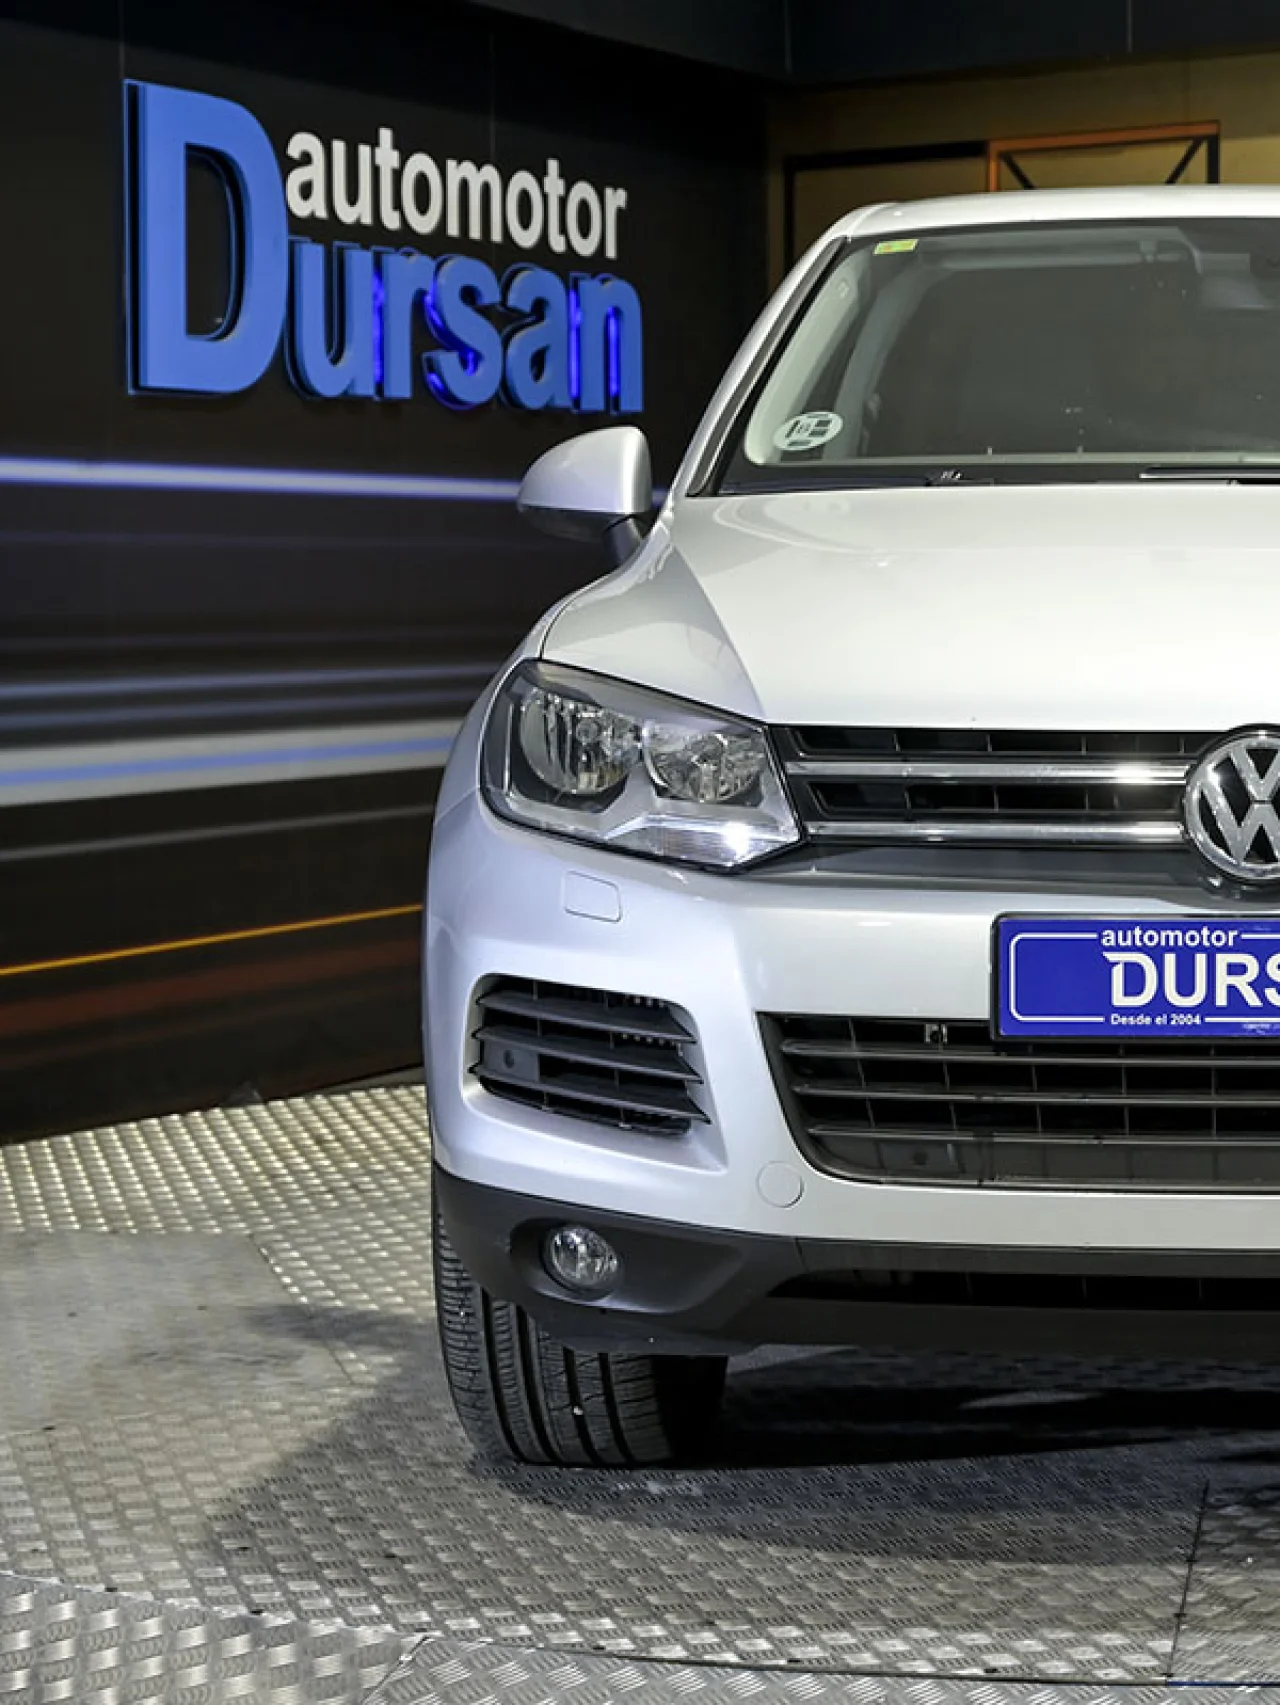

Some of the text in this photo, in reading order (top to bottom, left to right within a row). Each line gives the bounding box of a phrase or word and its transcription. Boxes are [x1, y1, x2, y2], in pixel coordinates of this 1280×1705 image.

[286, 127, 627, 259] automotor
[123, 78, 644, 414] Dursan
[1101, 926, 1238, 946] automotor
[1110, 1013, 1202, 1025] Desde el 2004
